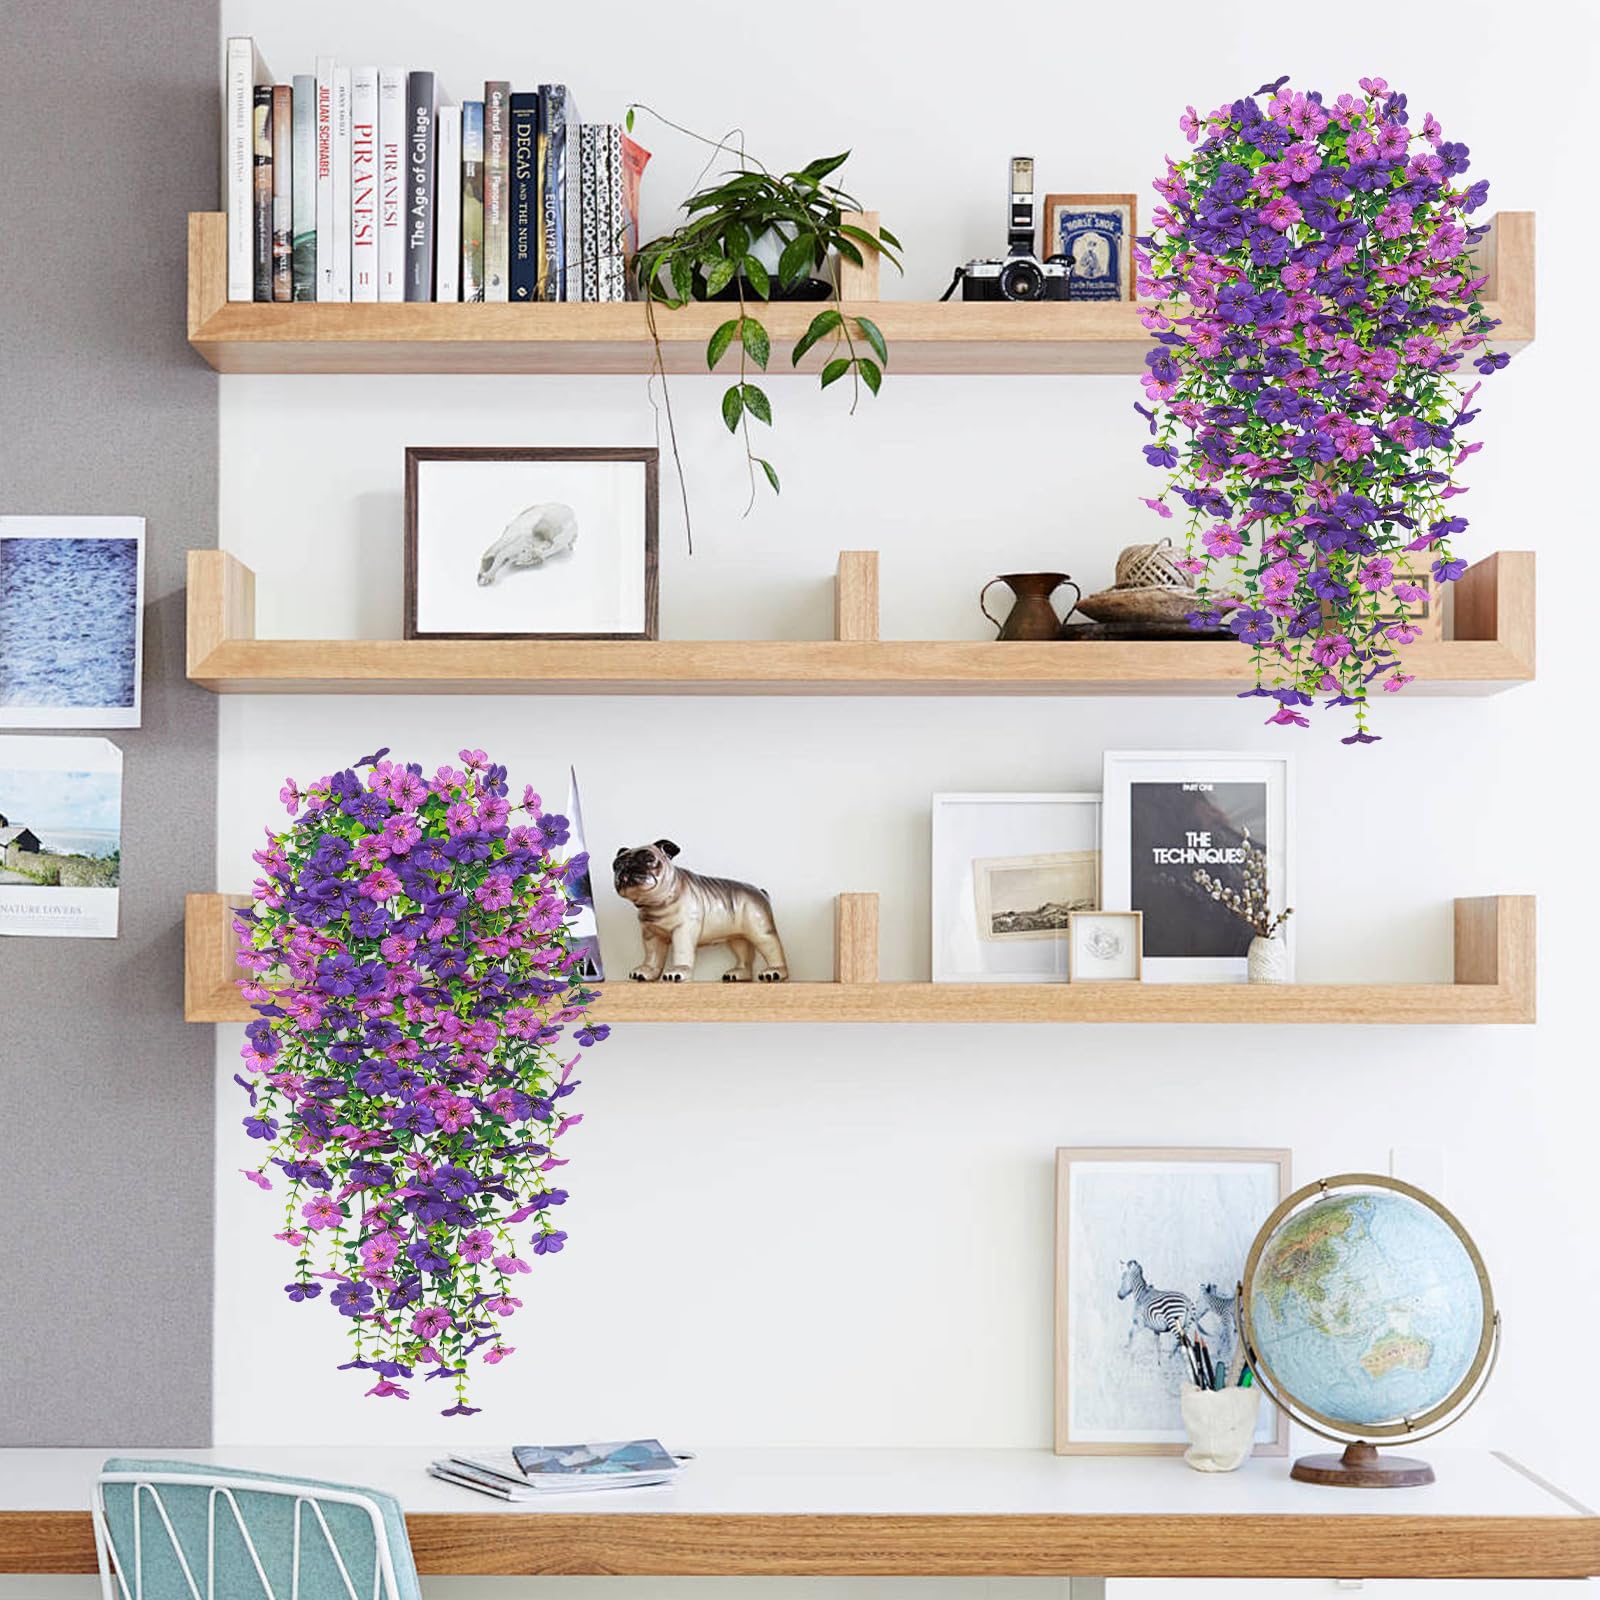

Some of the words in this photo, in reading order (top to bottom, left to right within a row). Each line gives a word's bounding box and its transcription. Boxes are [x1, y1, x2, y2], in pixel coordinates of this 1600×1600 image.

[319, 86, 330, 123] JULIAN
[492, 91, 502, 132] Gerhard
[413, 107, 428, 164] Collage
[491, 135, 502, 168] Richter
[516, 123, 531, 179] DEGAS
[319, 126, 330, 180] SCHNABEL
[354, 125, 373, 246] PIRANESI
[384, 143, 398, 227] PIRANESI
[413, 166, 426, 182] of
[412, 188, 428, 216] Age
[492, 175, 502, 225] Panorama
[519, 182, 527, 200] AND
[518, 203, 528, 225] THE
[544, 194, 556, 261] EUCALYPTS
[411, 223, 424, 248] The
[518, 227, 528, 260] NUDE
[1182, 784, 1199, 792] PART
[1199, 784, 1214, 792] ONE
[1185, 831, 1212, 848] THE
[1152, 848, 1247, 865] TECHNIQUES
